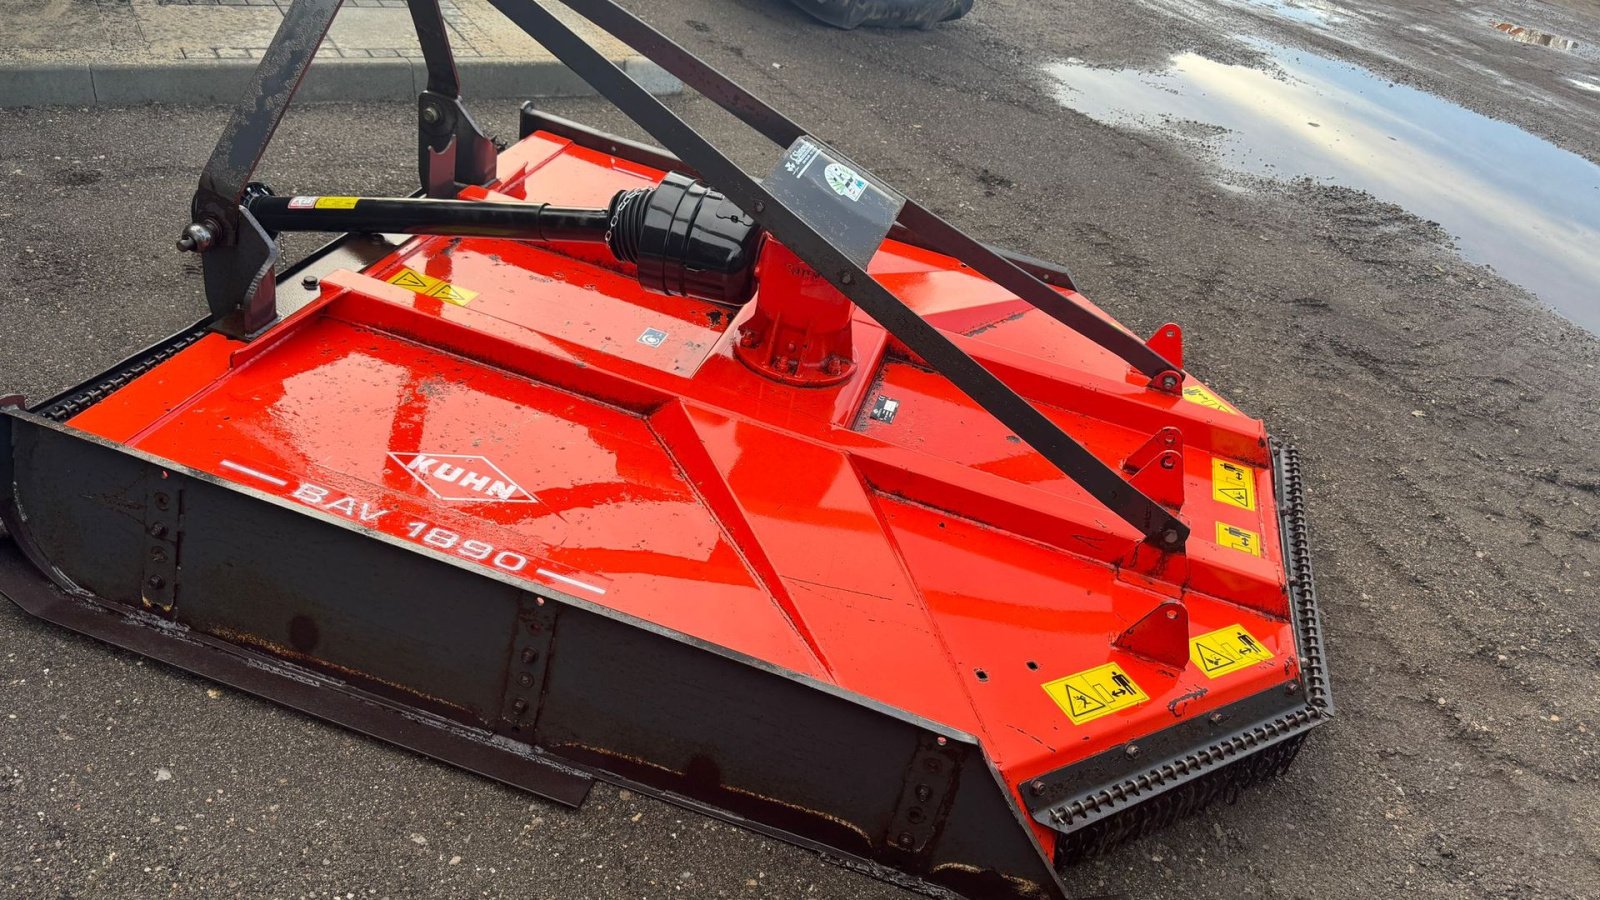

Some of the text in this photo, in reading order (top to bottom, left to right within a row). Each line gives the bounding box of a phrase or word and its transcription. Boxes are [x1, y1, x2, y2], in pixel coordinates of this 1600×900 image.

[406, 454, 518, 501] KUHN
[292, 482, 528, 572] BAV 1890
